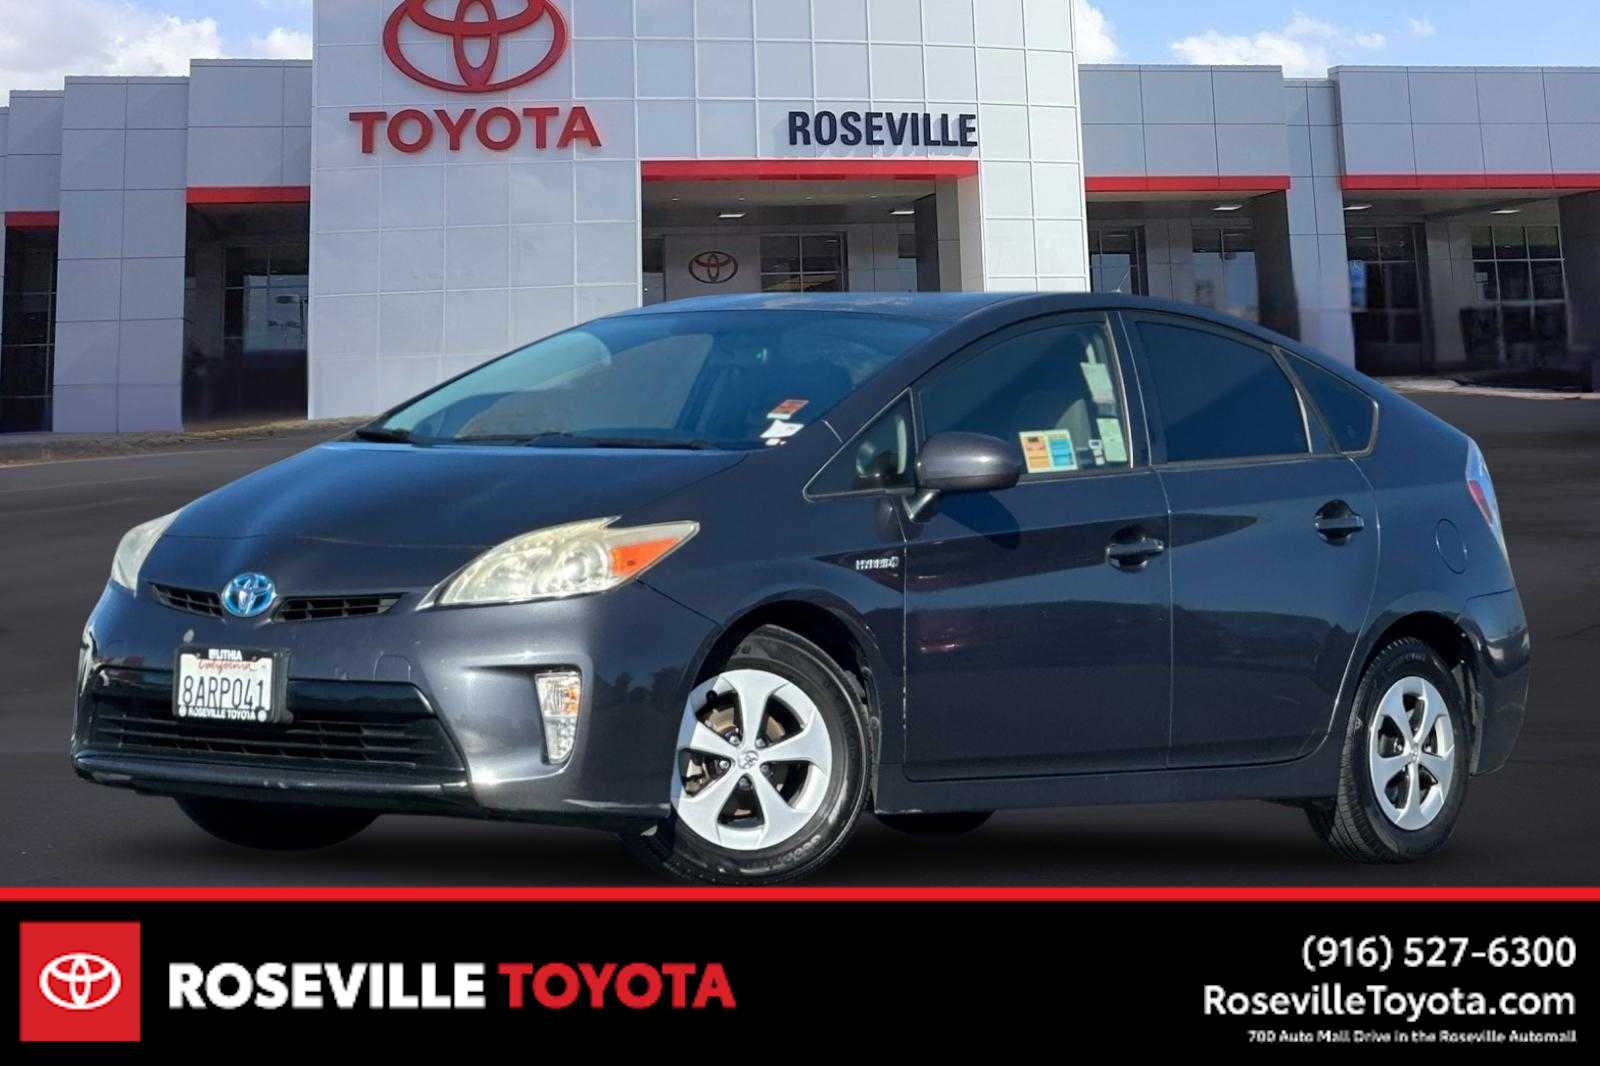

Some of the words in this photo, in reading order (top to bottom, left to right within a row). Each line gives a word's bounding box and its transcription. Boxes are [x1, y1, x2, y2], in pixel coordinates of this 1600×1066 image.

[349, 106, 602, 154] TOYOTA
[788, 110, 978, 147] ROSEVILLE
[183, 675, 264, 709] 8ARP041
[228, 709, 256, 720] TOYOTA
